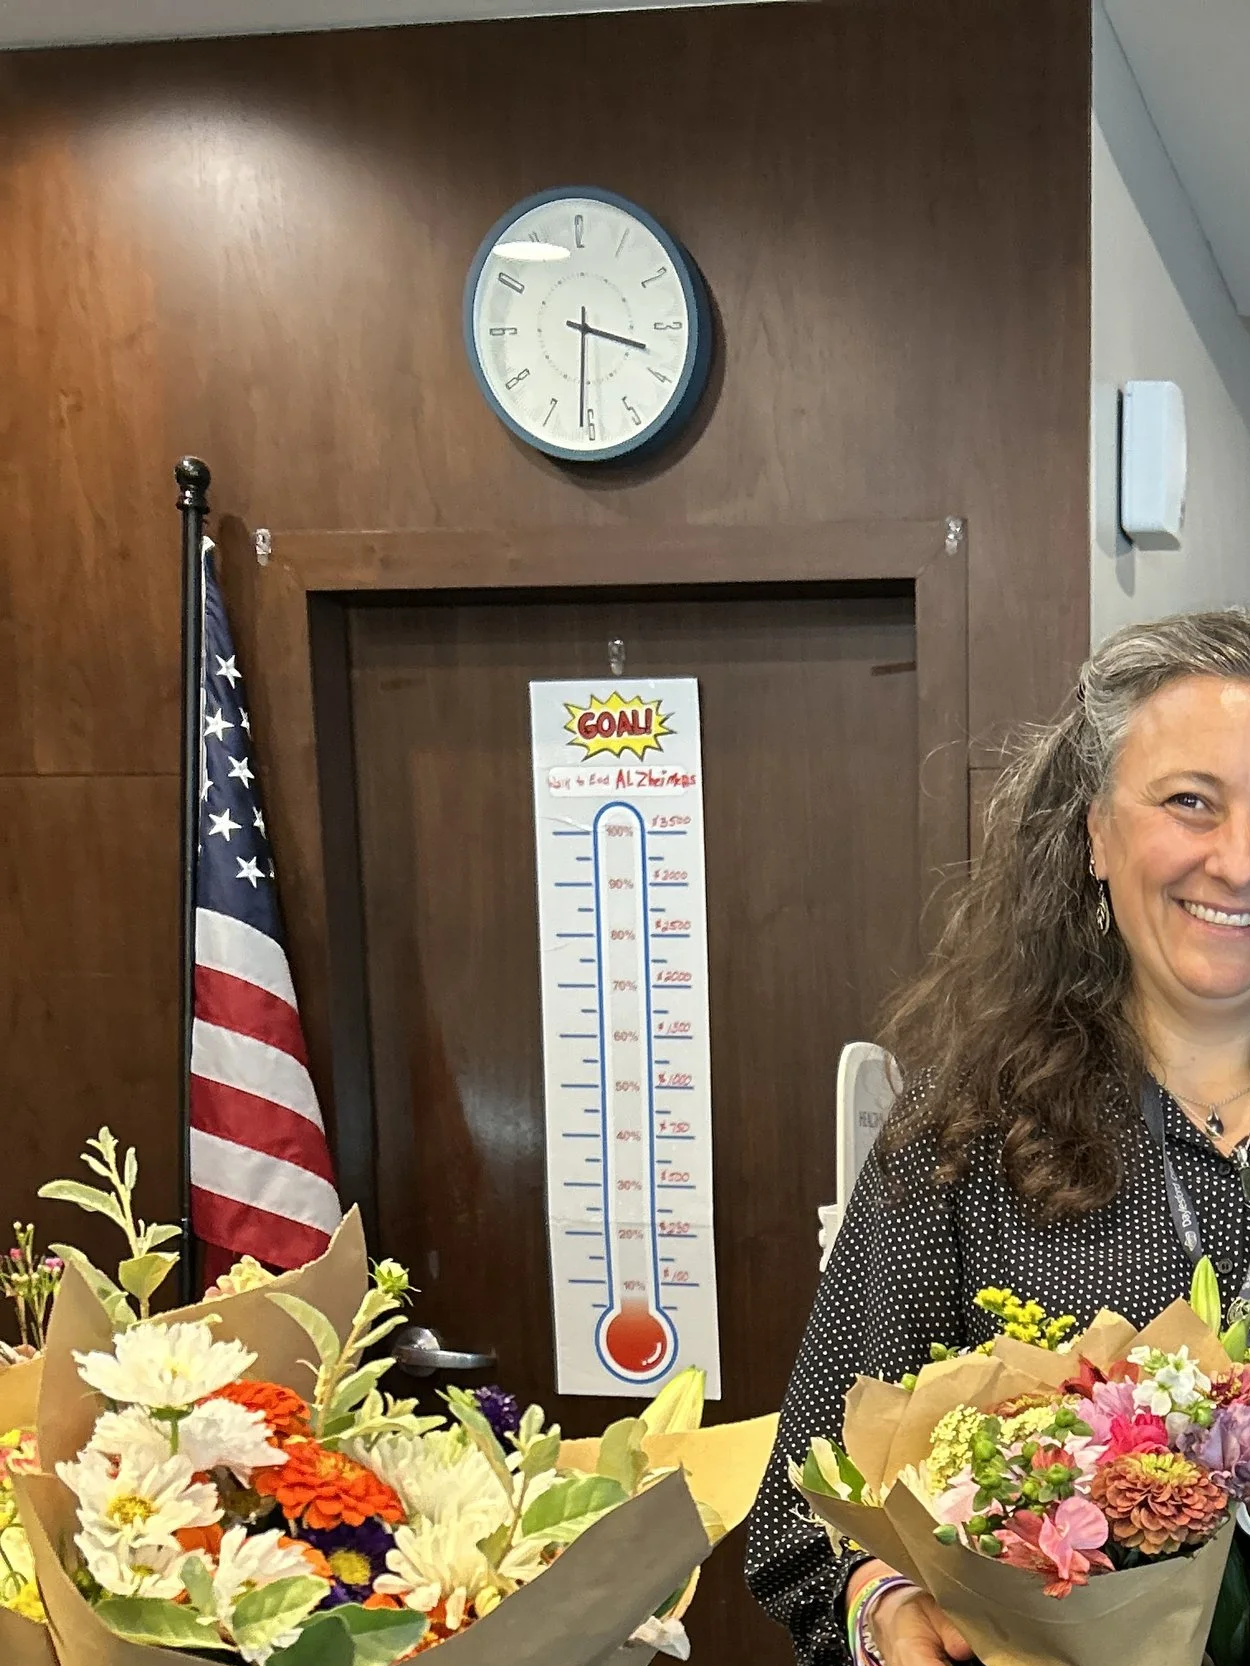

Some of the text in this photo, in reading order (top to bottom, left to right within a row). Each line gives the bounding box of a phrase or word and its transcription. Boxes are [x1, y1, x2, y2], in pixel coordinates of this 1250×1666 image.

[641, 267, 667, 288] 2
[654, 321, 682, 331] 3
[505, 368, 530, 390] 8
[647, 367, 673, 383] 4
[543, 398, 558, 427] 7
[622, 396, 641, 425] 5
[587, 408, 596, 441] 6
[577, 707, 653, 740] GOAL!
[608, 878, 634, 889] 90%
[610, 930, 635, 941] 80%
[613, 980, 637, 991] 70%
[614, 1031, 639, 1042] 60%
[615, 1081, 640, 1092] 50%
[616, 1130, 642, 1142] 40%
[617, 1180, 642, 1190] 30%
[618, 1229, 643, 1239] 20%
[623, 1280, 646, 1291] 10%
